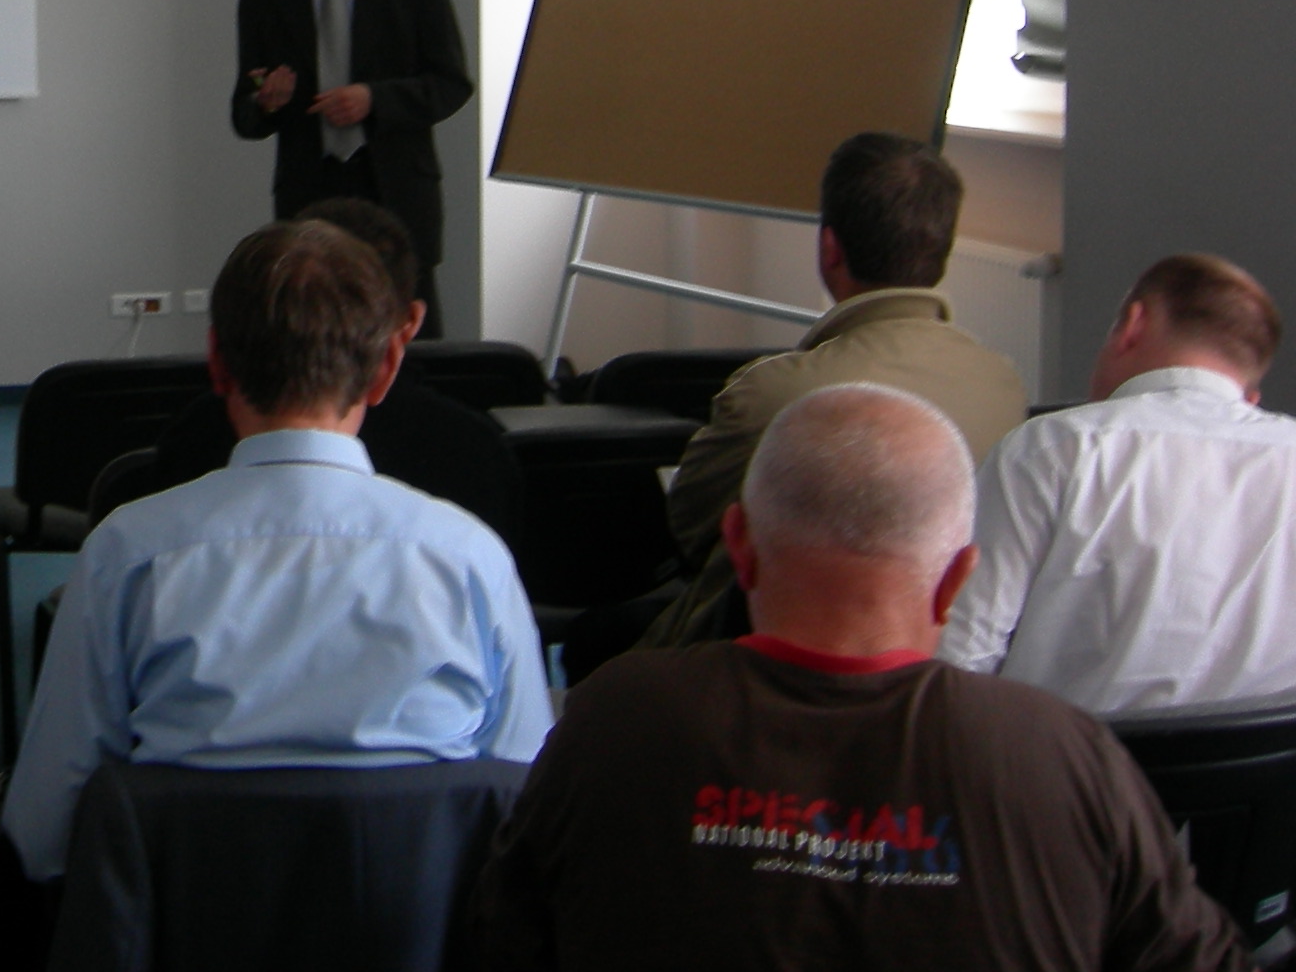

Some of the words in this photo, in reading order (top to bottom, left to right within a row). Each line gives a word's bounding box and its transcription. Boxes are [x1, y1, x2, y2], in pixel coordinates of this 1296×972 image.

[690, 783, 940, 852] SPECIAL
[690, 823, 790, 850] NATIONAL
[794, 829, 887, 862] PROJECT
